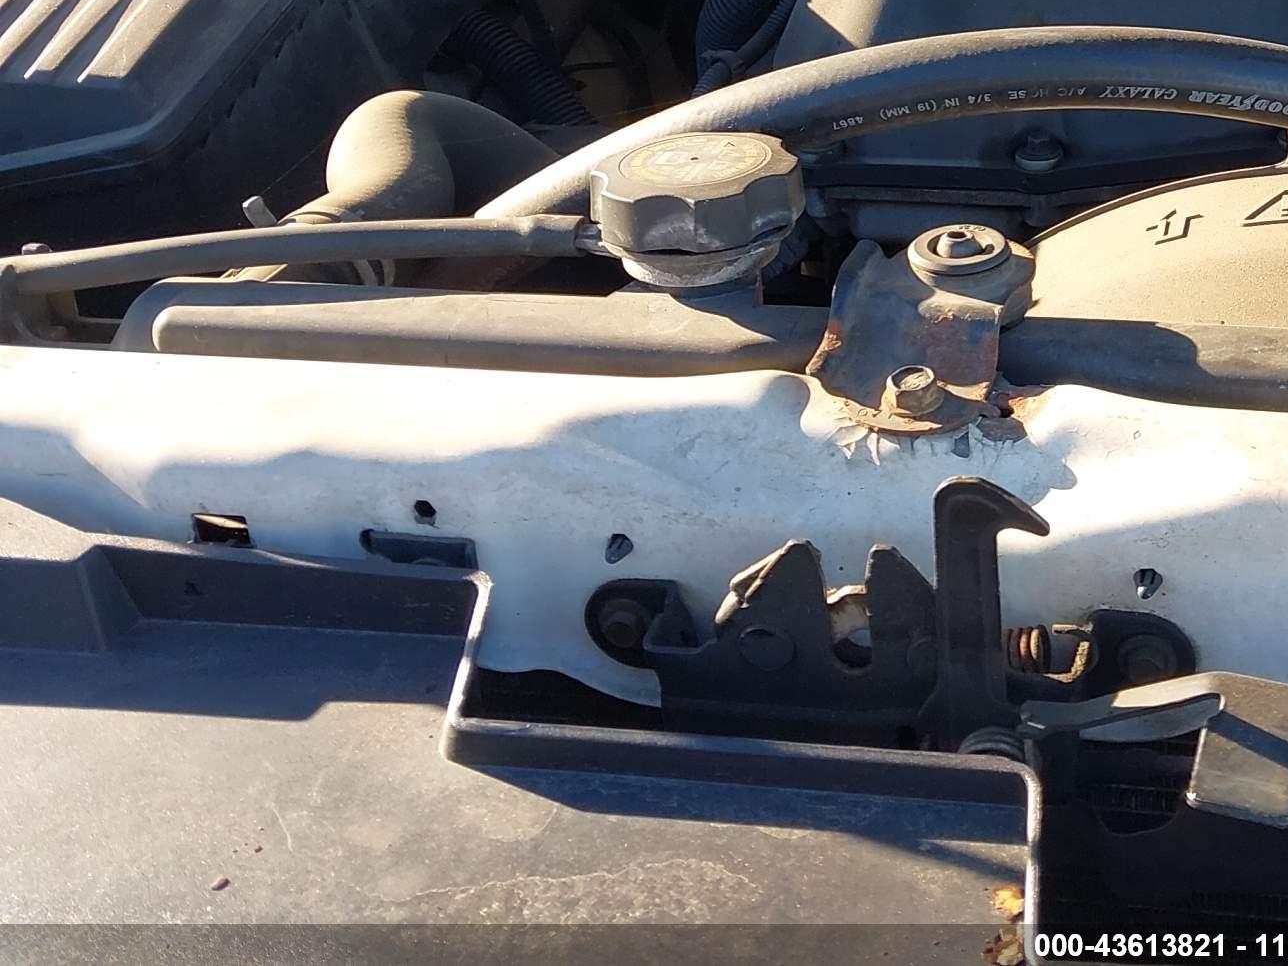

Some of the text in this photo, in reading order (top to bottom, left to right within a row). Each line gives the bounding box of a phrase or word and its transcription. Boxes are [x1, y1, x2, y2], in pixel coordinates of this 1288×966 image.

[967, 93, 992, 105] 3/4
[1098, 86, 1178, 100] GALAXY
[917, 100, 937, 113] (19
[944, 97, 960, 109] IN
[879, 104, 911, 120] MM)
[832, 116, 864, 131] 4867
